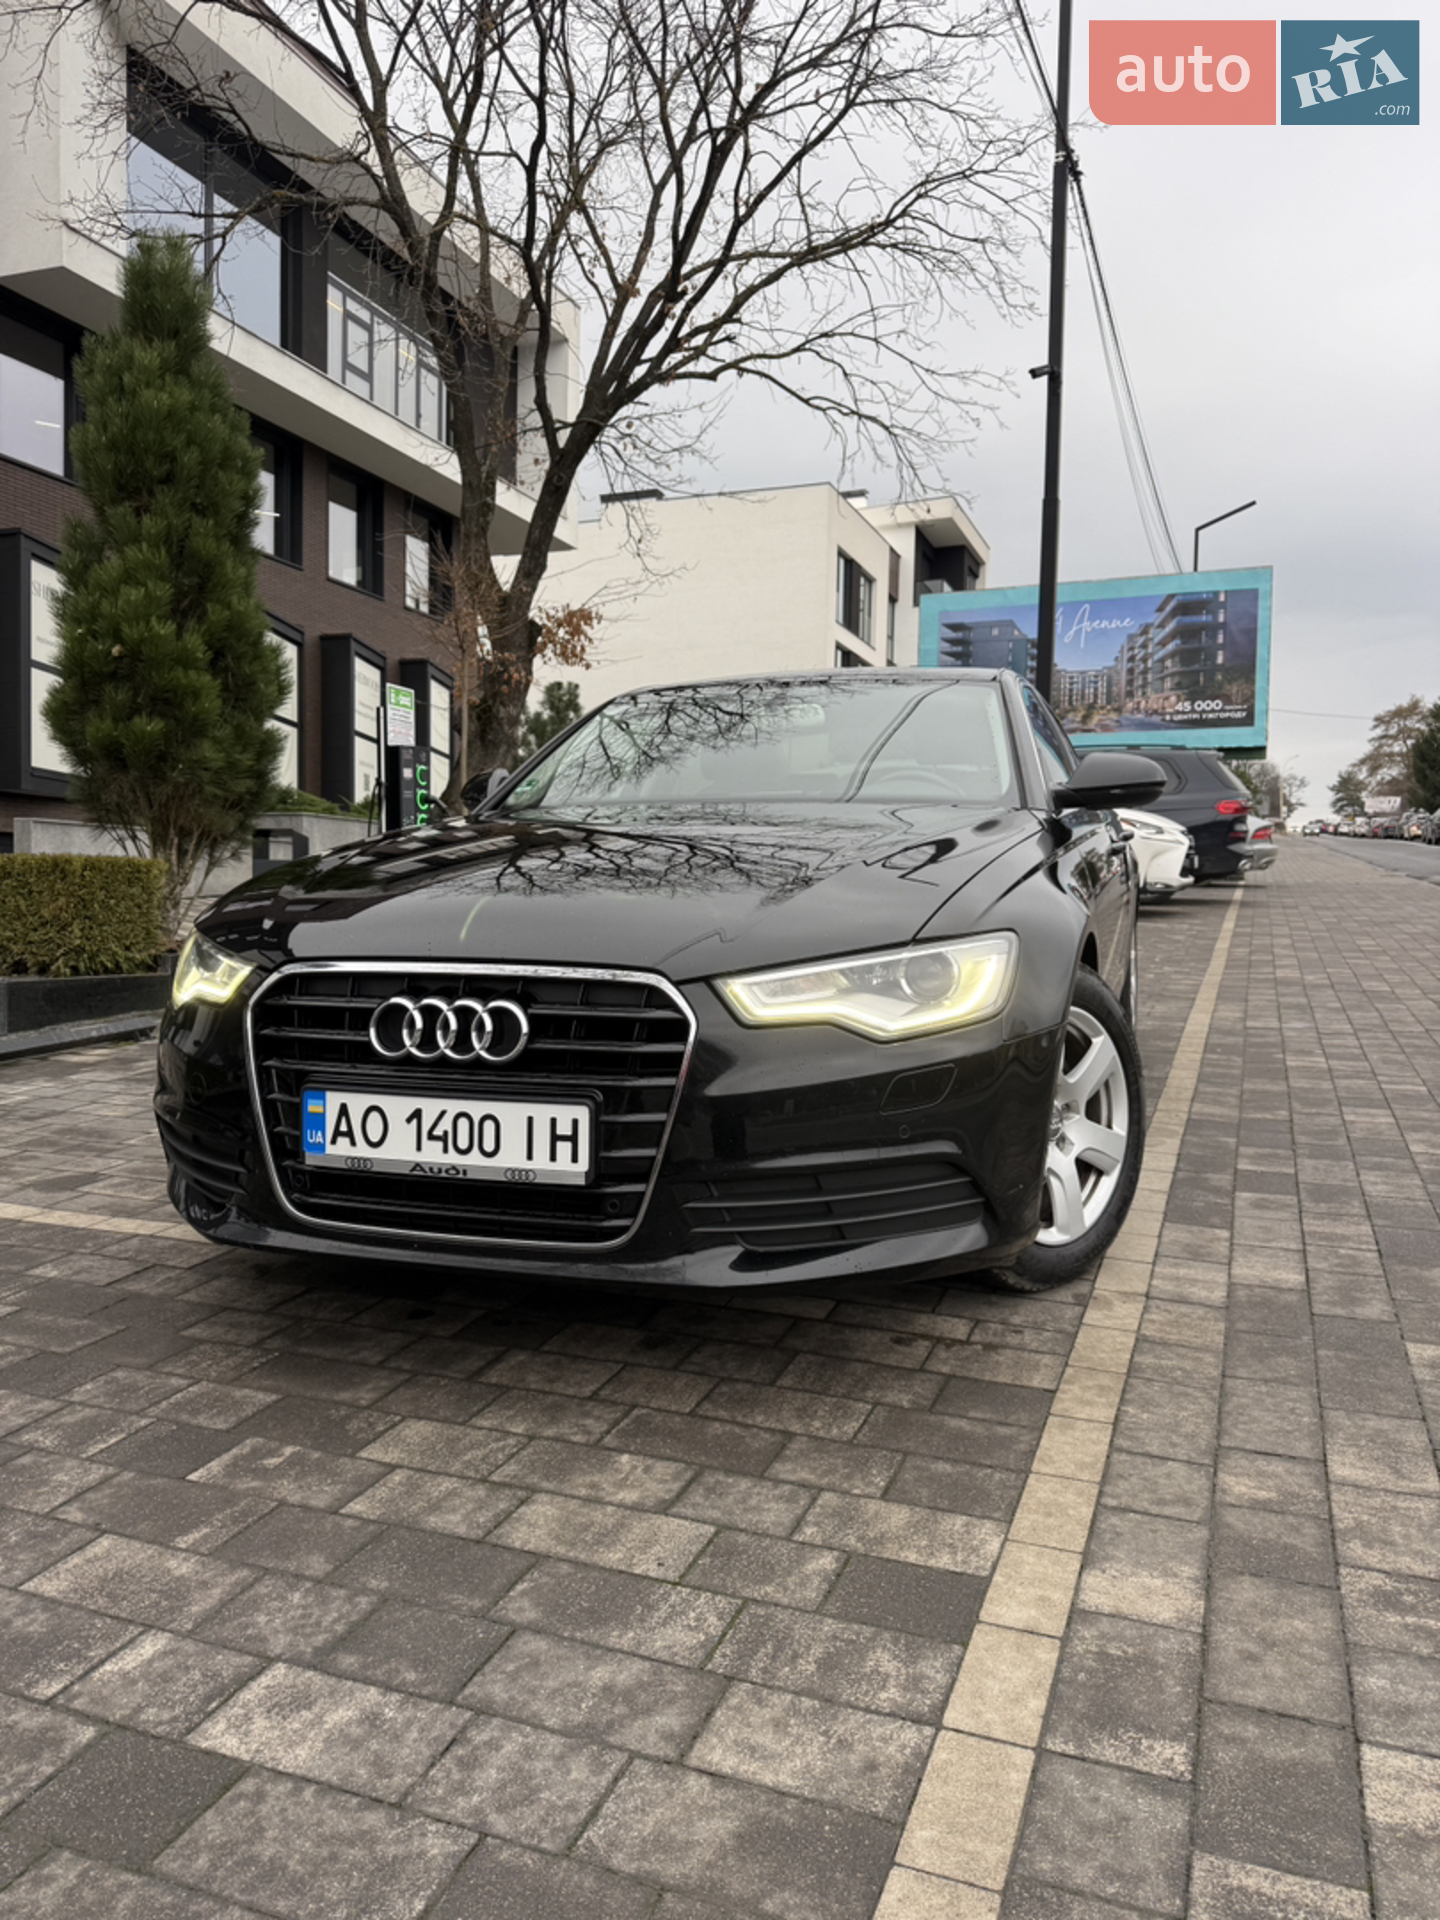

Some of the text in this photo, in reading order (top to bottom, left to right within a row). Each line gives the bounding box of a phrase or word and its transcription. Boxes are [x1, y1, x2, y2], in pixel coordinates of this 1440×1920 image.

[307, 1130, 324, 1144] UA
[330, 1102, 579, 1164] AO 1400 IH
[409, 1162, 467, 1177] Audi
